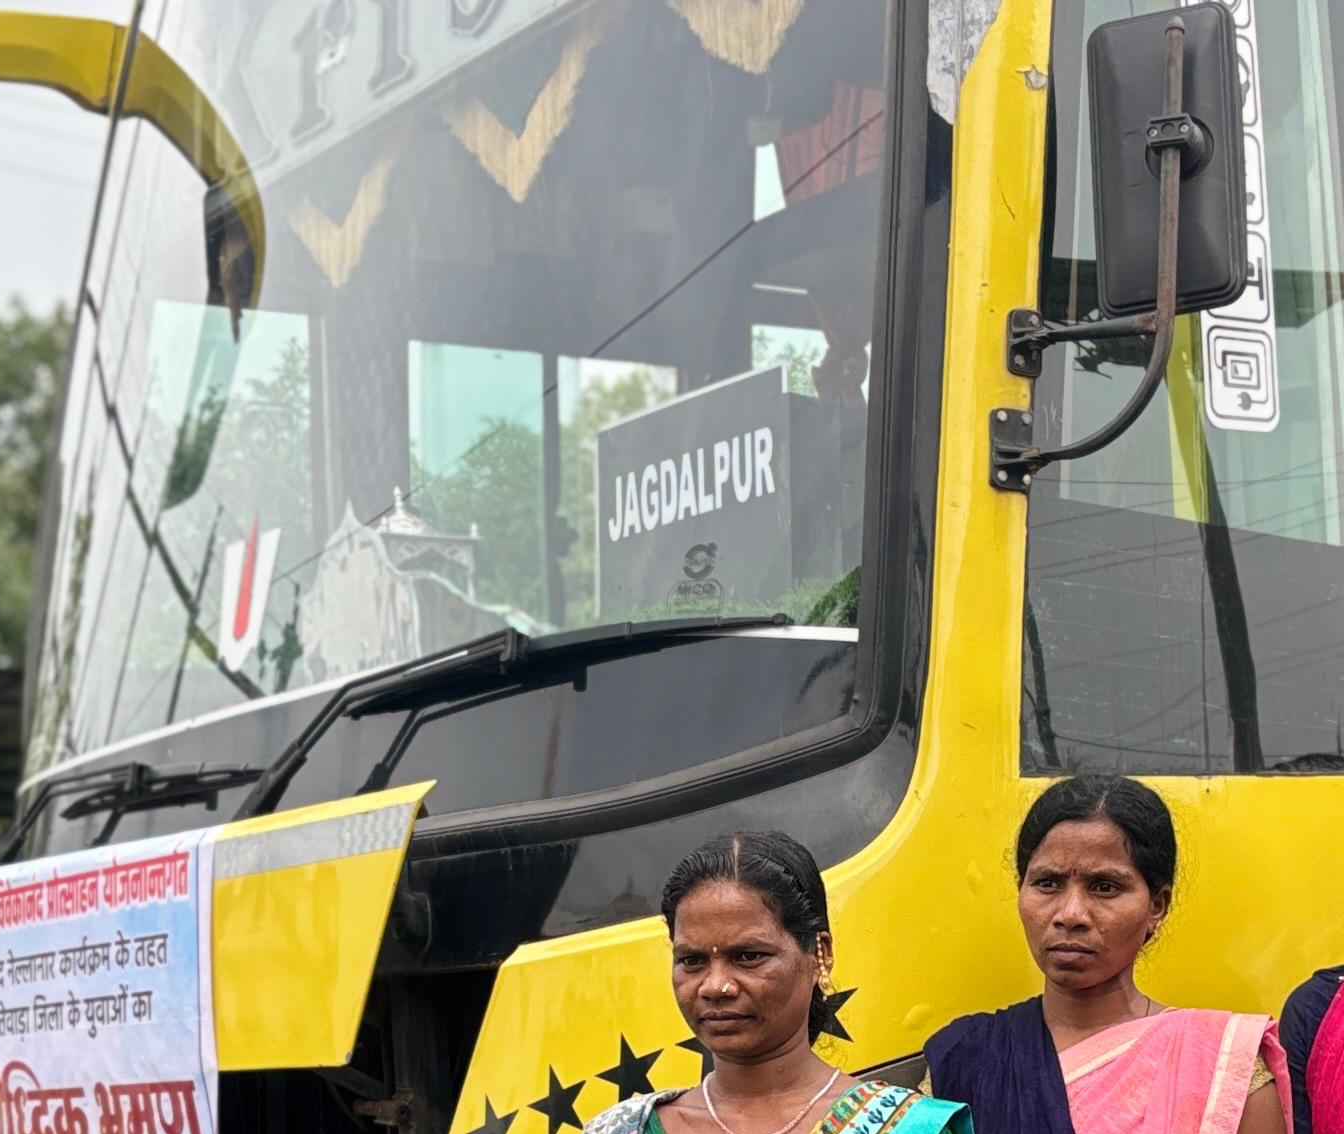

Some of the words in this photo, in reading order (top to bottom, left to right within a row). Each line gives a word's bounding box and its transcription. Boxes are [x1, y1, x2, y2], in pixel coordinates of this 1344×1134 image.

[608, 426, 776, 542] JAGDALPUR
[46, 867, 99, 919] प्रोत्साहन
[7, 950, 56, 985] नेल्लानार
[59, 935, 111, 977] कार्यक्रम
[115, 931, 130, 968] के
[134, 933, 168, 966] तहत
[33, 994, 64, 1032] जिला
[67, 990, 80, 1027] के
[84, 984, 128, 1038] युवाओं
[132, 990, 153, 1022] का
